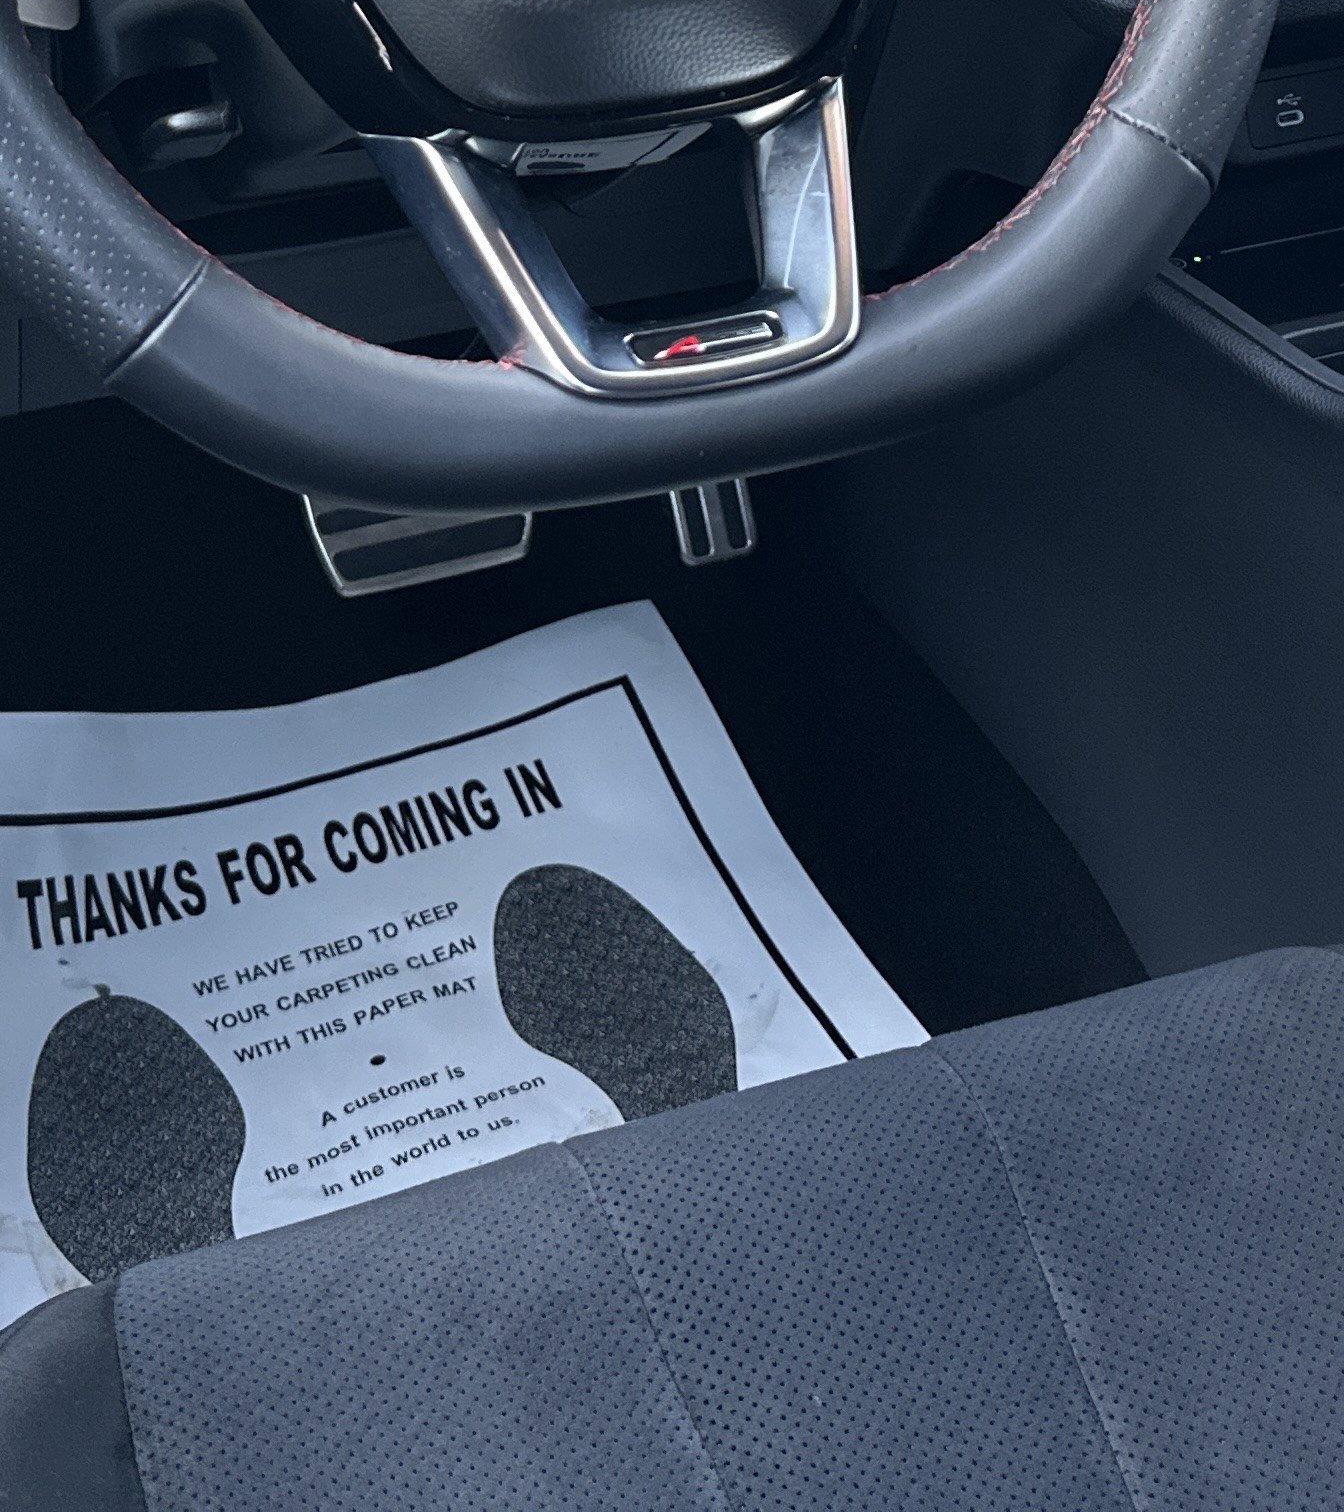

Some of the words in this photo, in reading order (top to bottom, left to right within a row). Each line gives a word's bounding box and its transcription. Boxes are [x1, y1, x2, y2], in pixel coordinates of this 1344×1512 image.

[17, 859, 207, 950] THANKS
[216, 833, 316, 905] FOR
[323, 778, 501, 873] COMING
[504, 758, 563, 820] IN
[192, 974, 230, 997] WE
[235, 954, 296, 986] HAVE
[299, 934, 364, 965] TRIED
[369, 922, 399, 943] TO
[405, 901, 459, 932] KEEP
[205, 1002, 270, 1032] YOUR
[276, 963, 399, 1011] CARPETING
[406, 934, 478, 970] CLEAN
[233, 1035, 292, 1063] WITH
[296, 1017, 347, 1045] THIS
[353, 988, 428, 1026] PAPER
[431, 976, 478, 999] MAT
[264, 1163, 300, 1185] the
[306, 1134, 361, 1170] most
[365, 1098, 469, 1140] important
[474, 1075, 547, 1110] person
[321, 1109, 338, 1127] A
[343, 1071, 440, 1115] customer
[445, 1064, 466, 1081] is
[321, 1180, 344, 1197] in
[350, 1163, 385, 1187] the
[390, 1133, 452, 1168] world
[457, 1126, 480, 1141] to
[487, 1115, 521, 1132] us.
